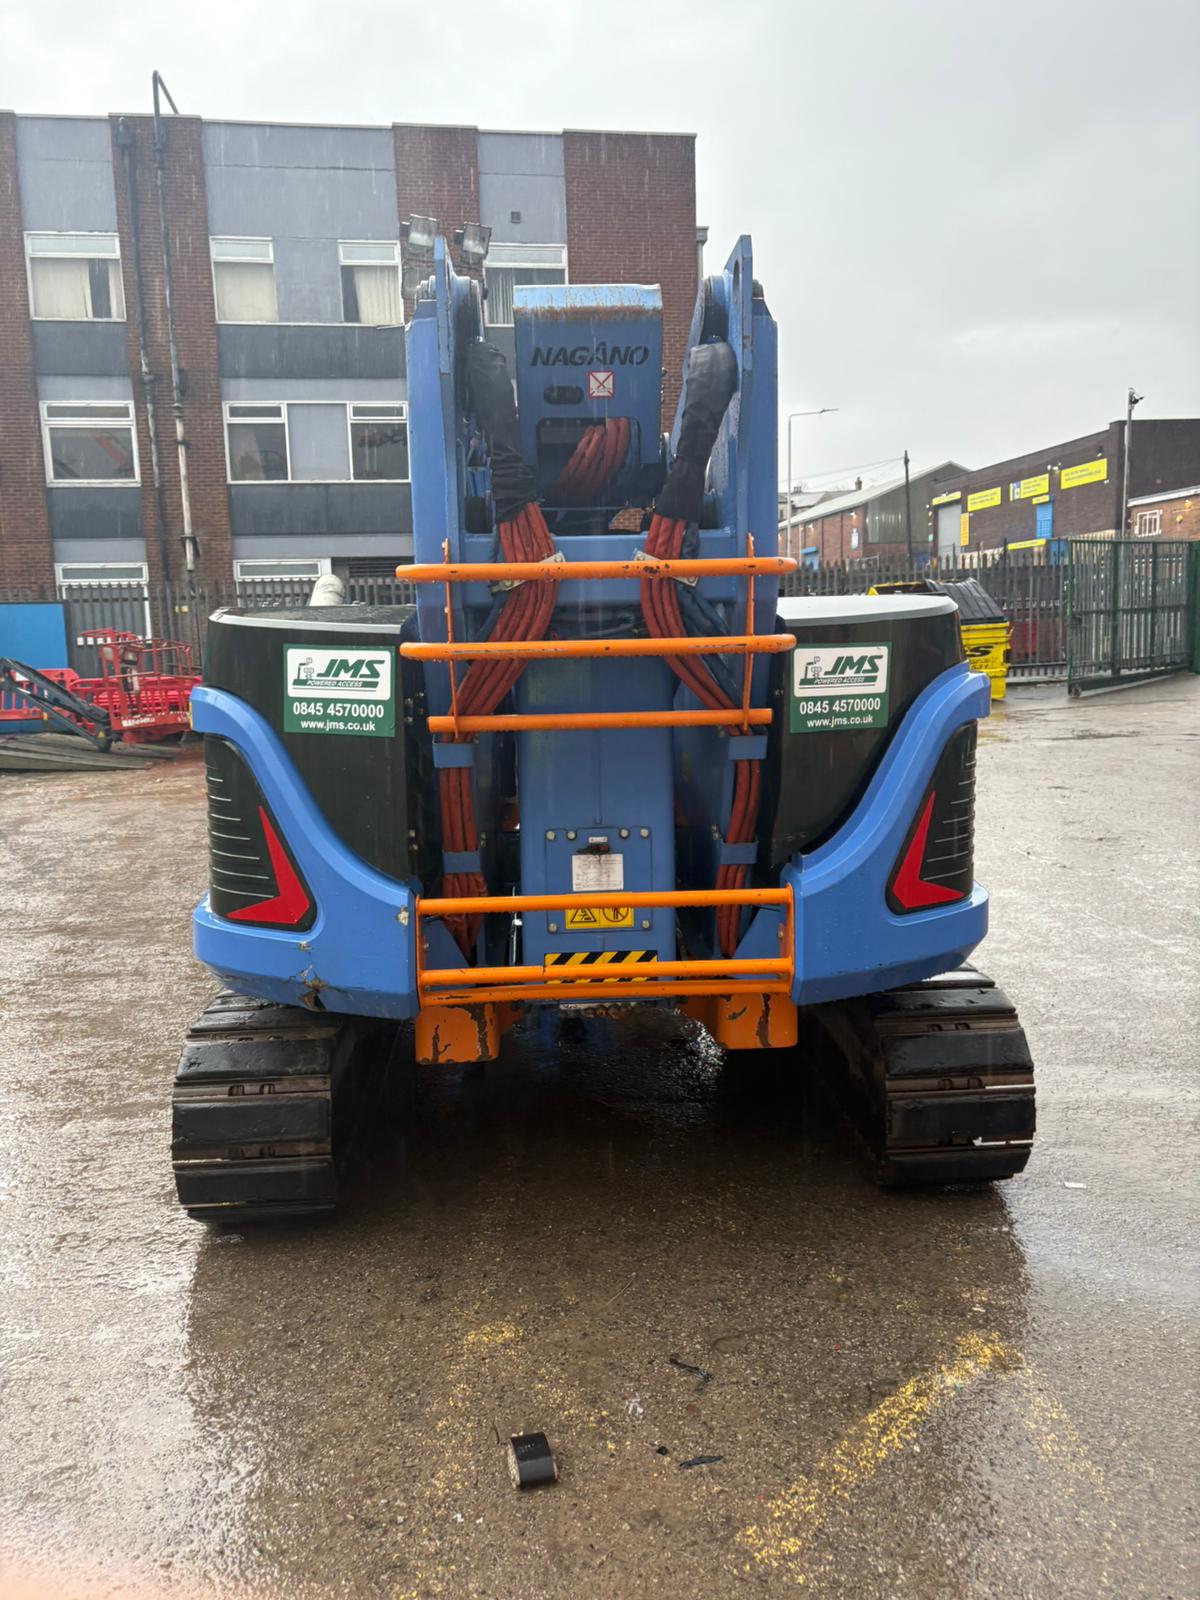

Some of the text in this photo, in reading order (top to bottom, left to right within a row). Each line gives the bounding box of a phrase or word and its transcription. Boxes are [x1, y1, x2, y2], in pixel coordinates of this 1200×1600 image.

[316, 658, 386, 679] JMS
[823, 654, 884, 676] JMS
[814, 676, 865, 685] POWERED ACCESS
[292, 702, 385, 718] 0845 4570000
[799, 697, 881, 715] 0845 4570000
[300, 719, 376, 731] www.jms.co.uk
[806, 714, 873, 728] www.jms.co.uk
